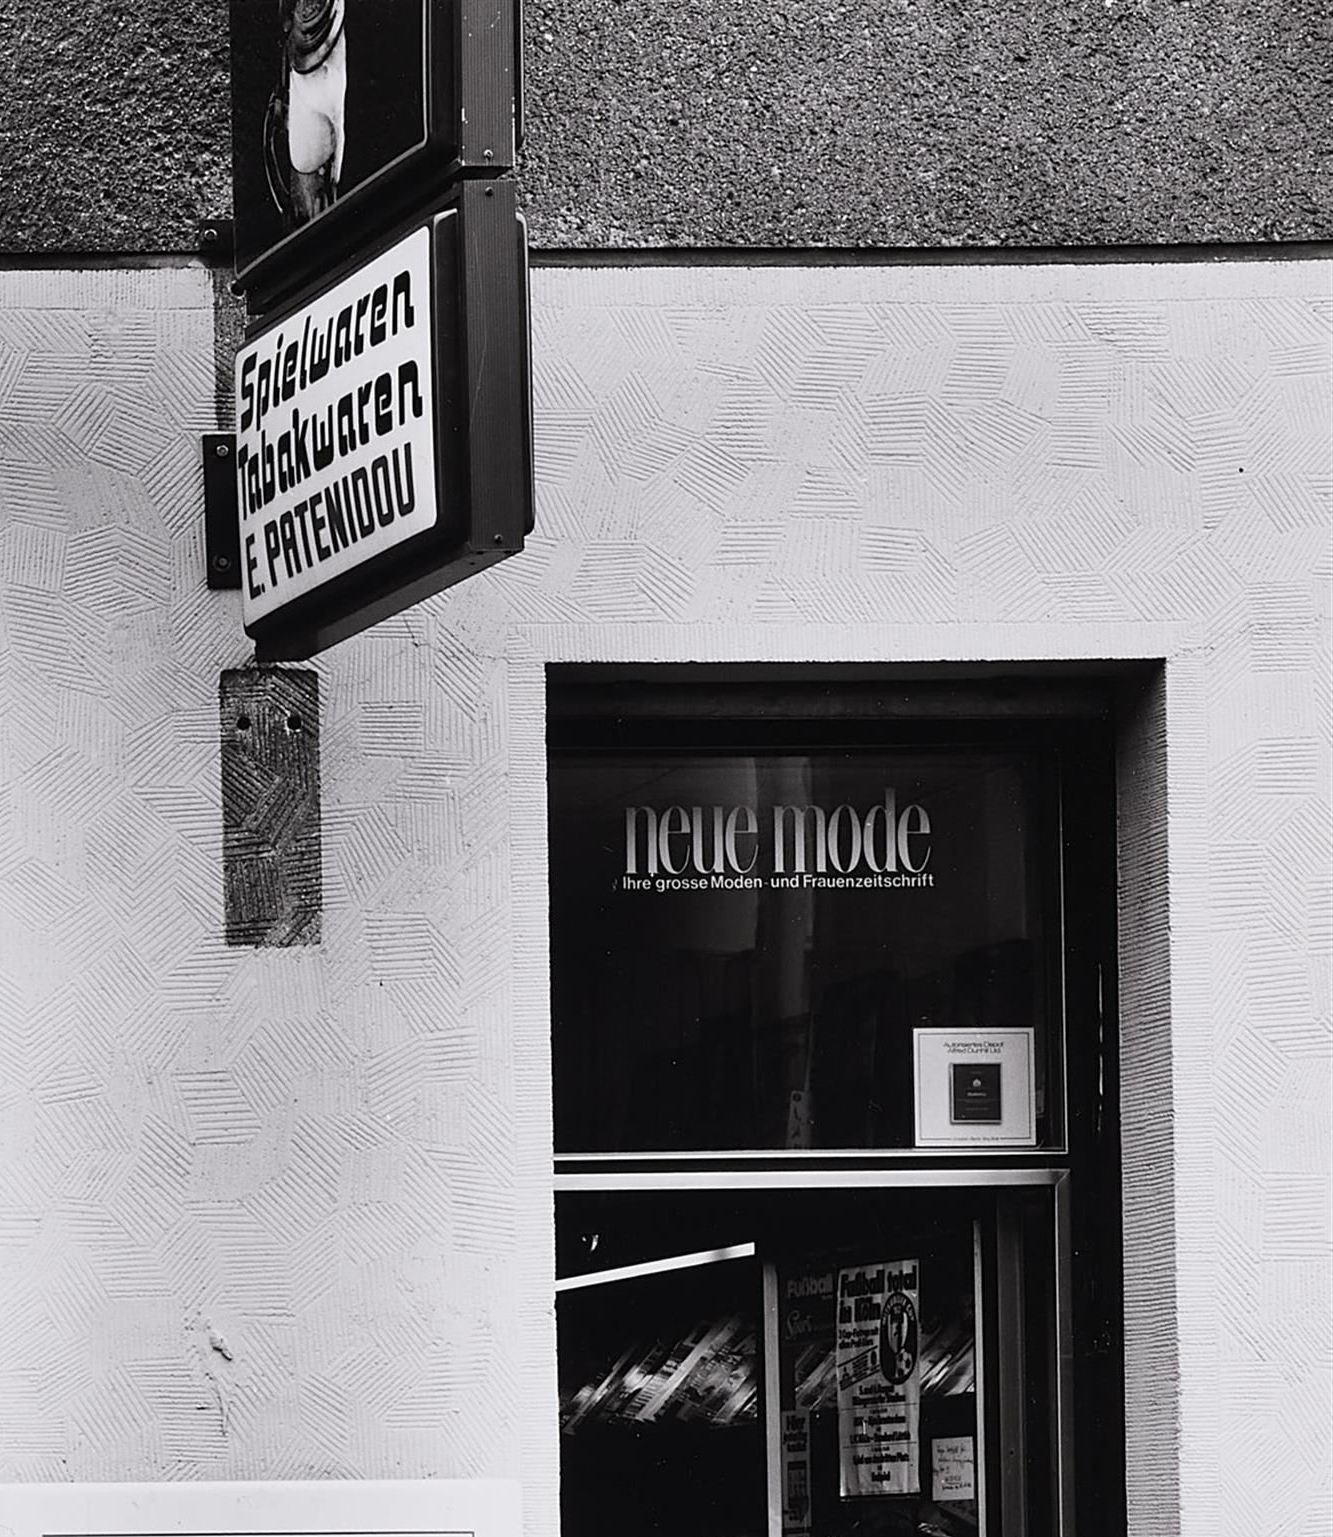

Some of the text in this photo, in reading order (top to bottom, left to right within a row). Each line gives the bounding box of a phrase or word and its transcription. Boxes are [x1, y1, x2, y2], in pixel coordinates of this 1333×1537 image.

[240, 269, 414, 432] Spielwaren
[238, 358, 424, 520] Tabakwaren
[268, 442, 416, 581] PATENIDOU
[622, 876, 652, 891] Ihre
[655, 877, 708, 894] grosse
[802, 872, 935, 889] Frauenzeitschrift
[624, 787, 932, 875] neue mode
